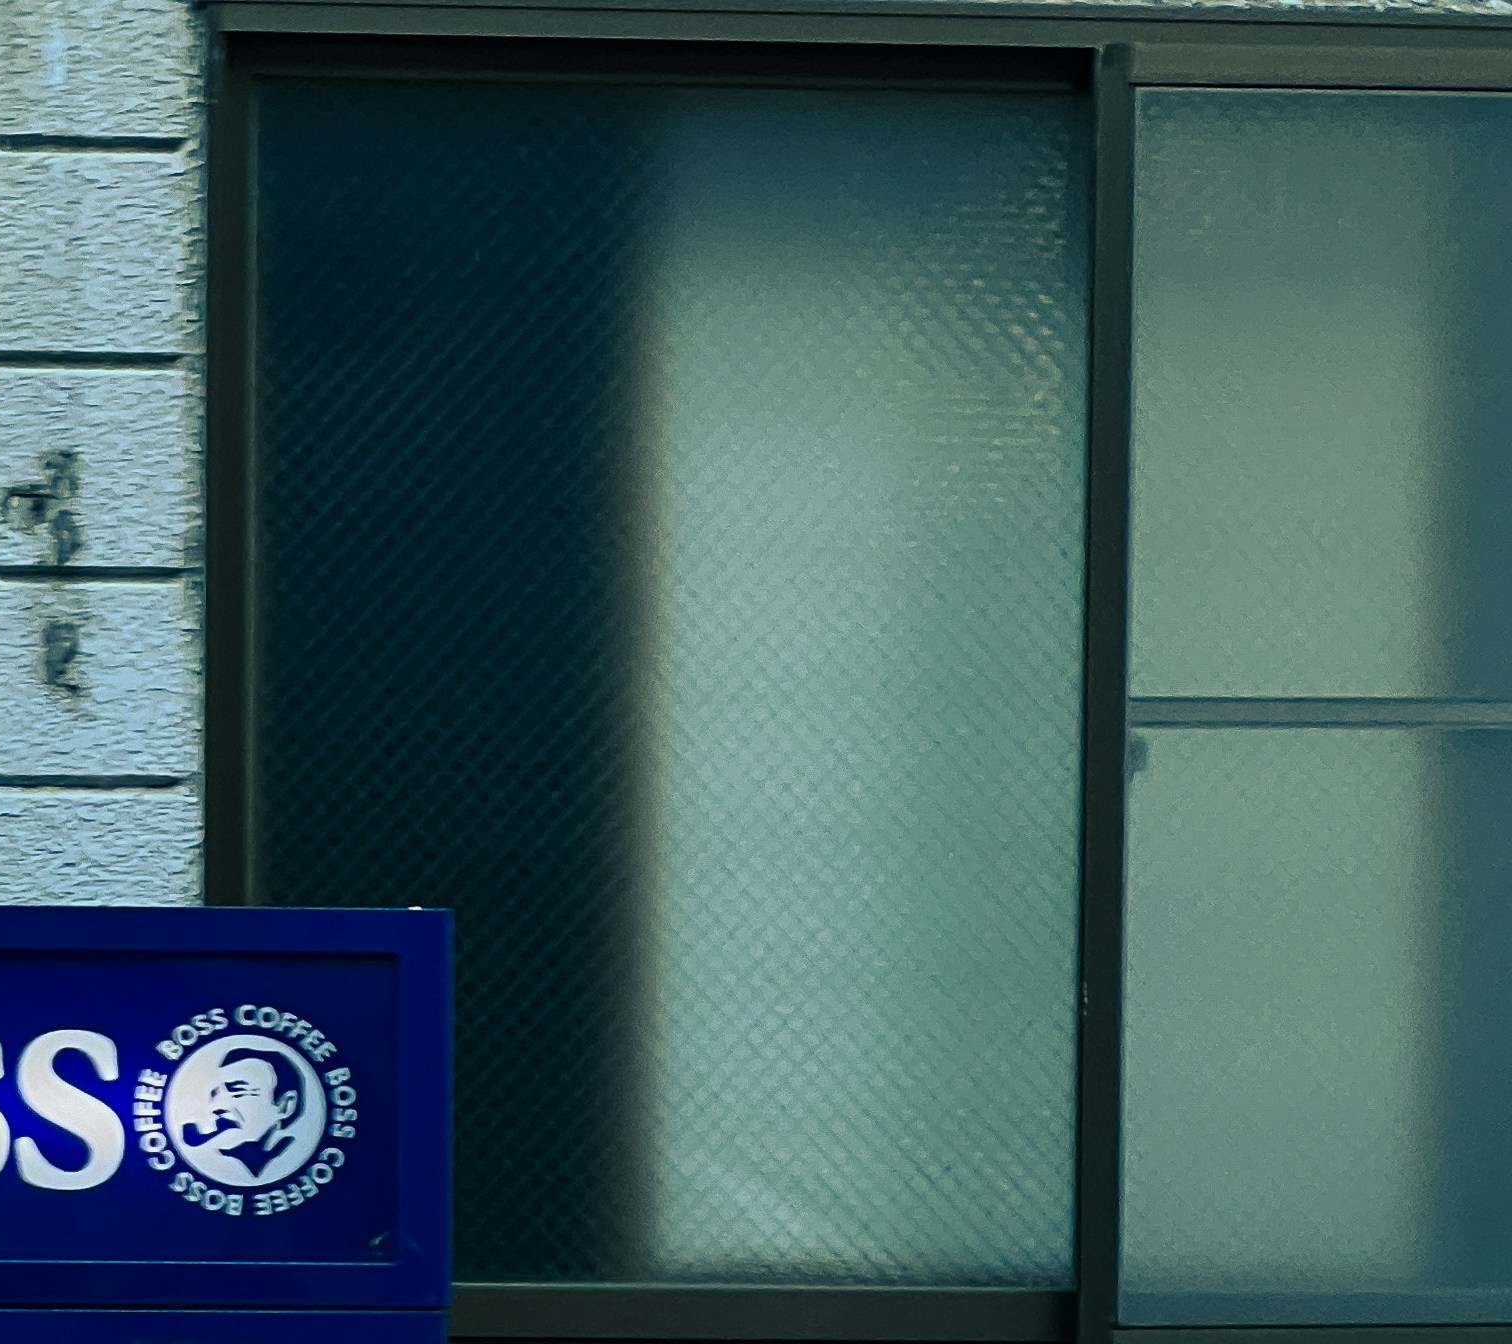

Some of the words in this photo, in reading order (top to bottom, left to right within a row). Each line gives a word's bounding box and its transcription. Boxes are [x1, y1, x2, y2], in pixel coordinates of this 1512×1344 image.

[155, 1008, 229, 1061] BOSS
[235, 1004, 338, 1062] COFFEE
[133, 1068, 176, 1171] COFFEE
[325, 1067, 358, 1139] BOSS
[168, 1171, 243, 1216] BOSS
[252, 1147, 346, 1216] COFFEE
